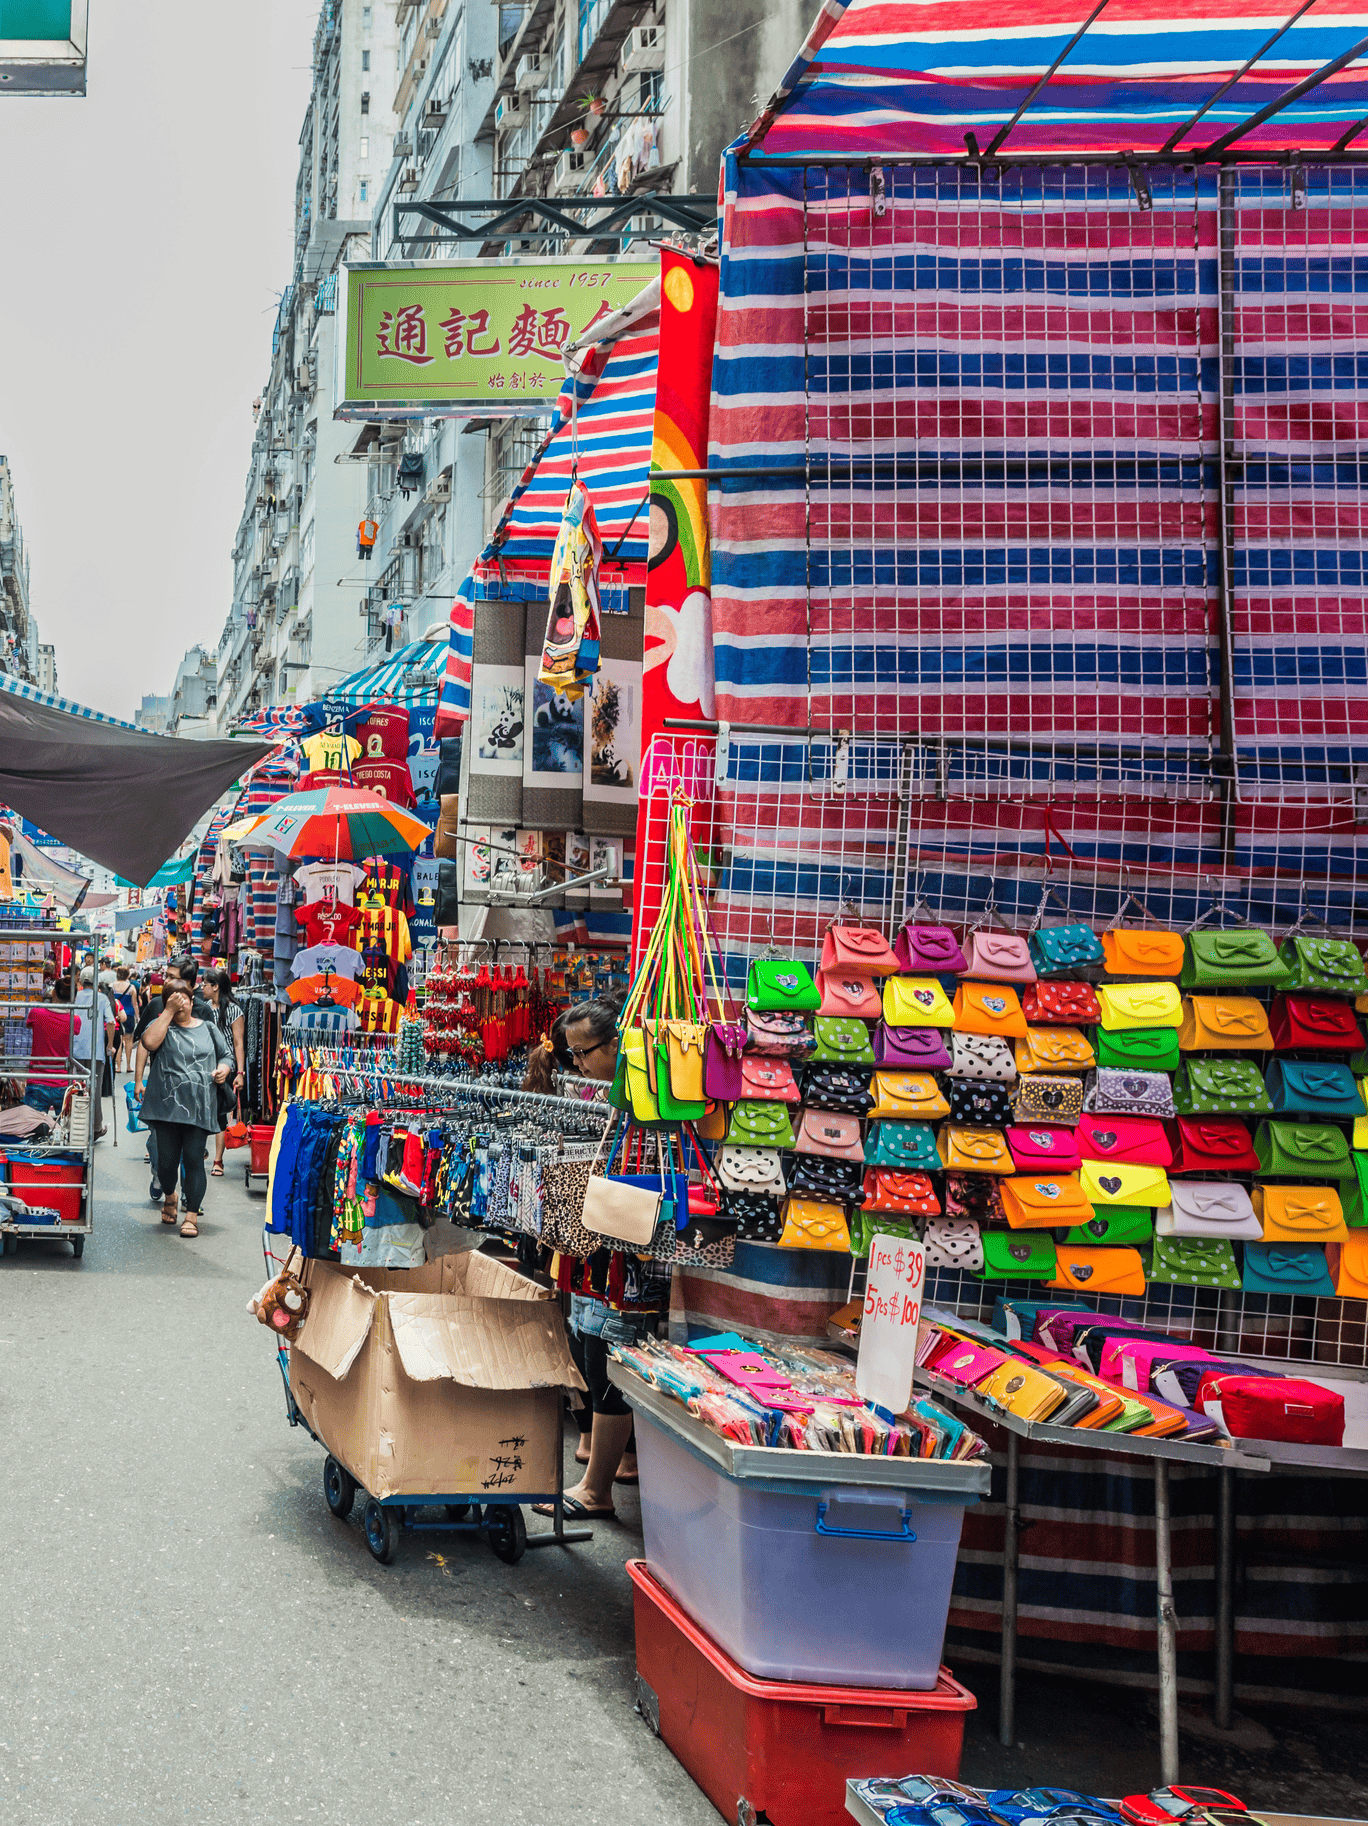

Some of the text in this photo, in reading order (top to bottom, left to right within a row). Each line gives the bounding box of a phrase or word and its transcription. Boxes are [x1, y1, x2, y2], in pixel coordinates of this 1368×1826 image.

[520, 272, 613, 289] since 1957
[374, 769, 391, 780] COSTA
